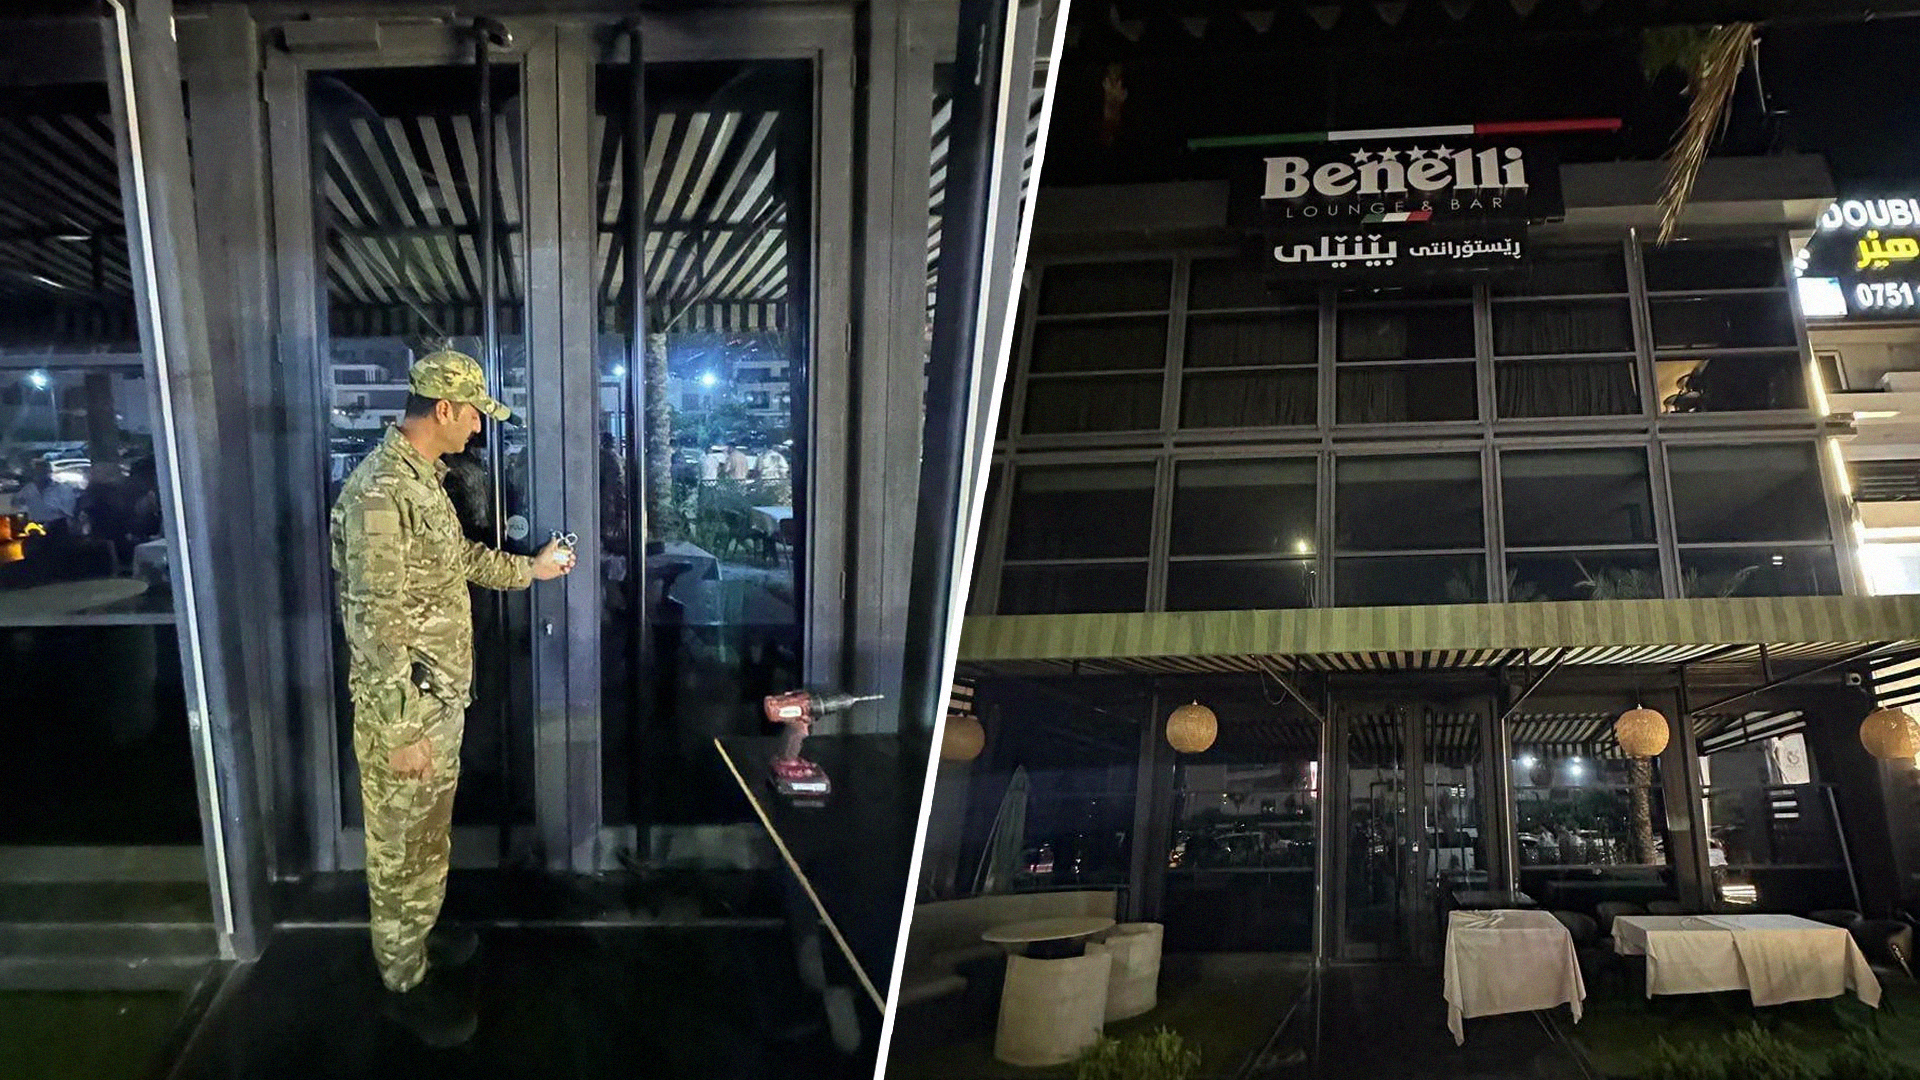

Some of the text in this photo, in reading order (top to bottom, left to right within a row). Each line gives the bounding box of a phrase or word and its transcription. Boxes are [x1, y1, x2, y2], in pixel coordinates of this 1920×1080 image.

[1261, 147, 1529, 200] Benelli
[1286, 197, 1503, 218] LOUNGE & BAR
[1856, 282, 1915, 307] 0751
